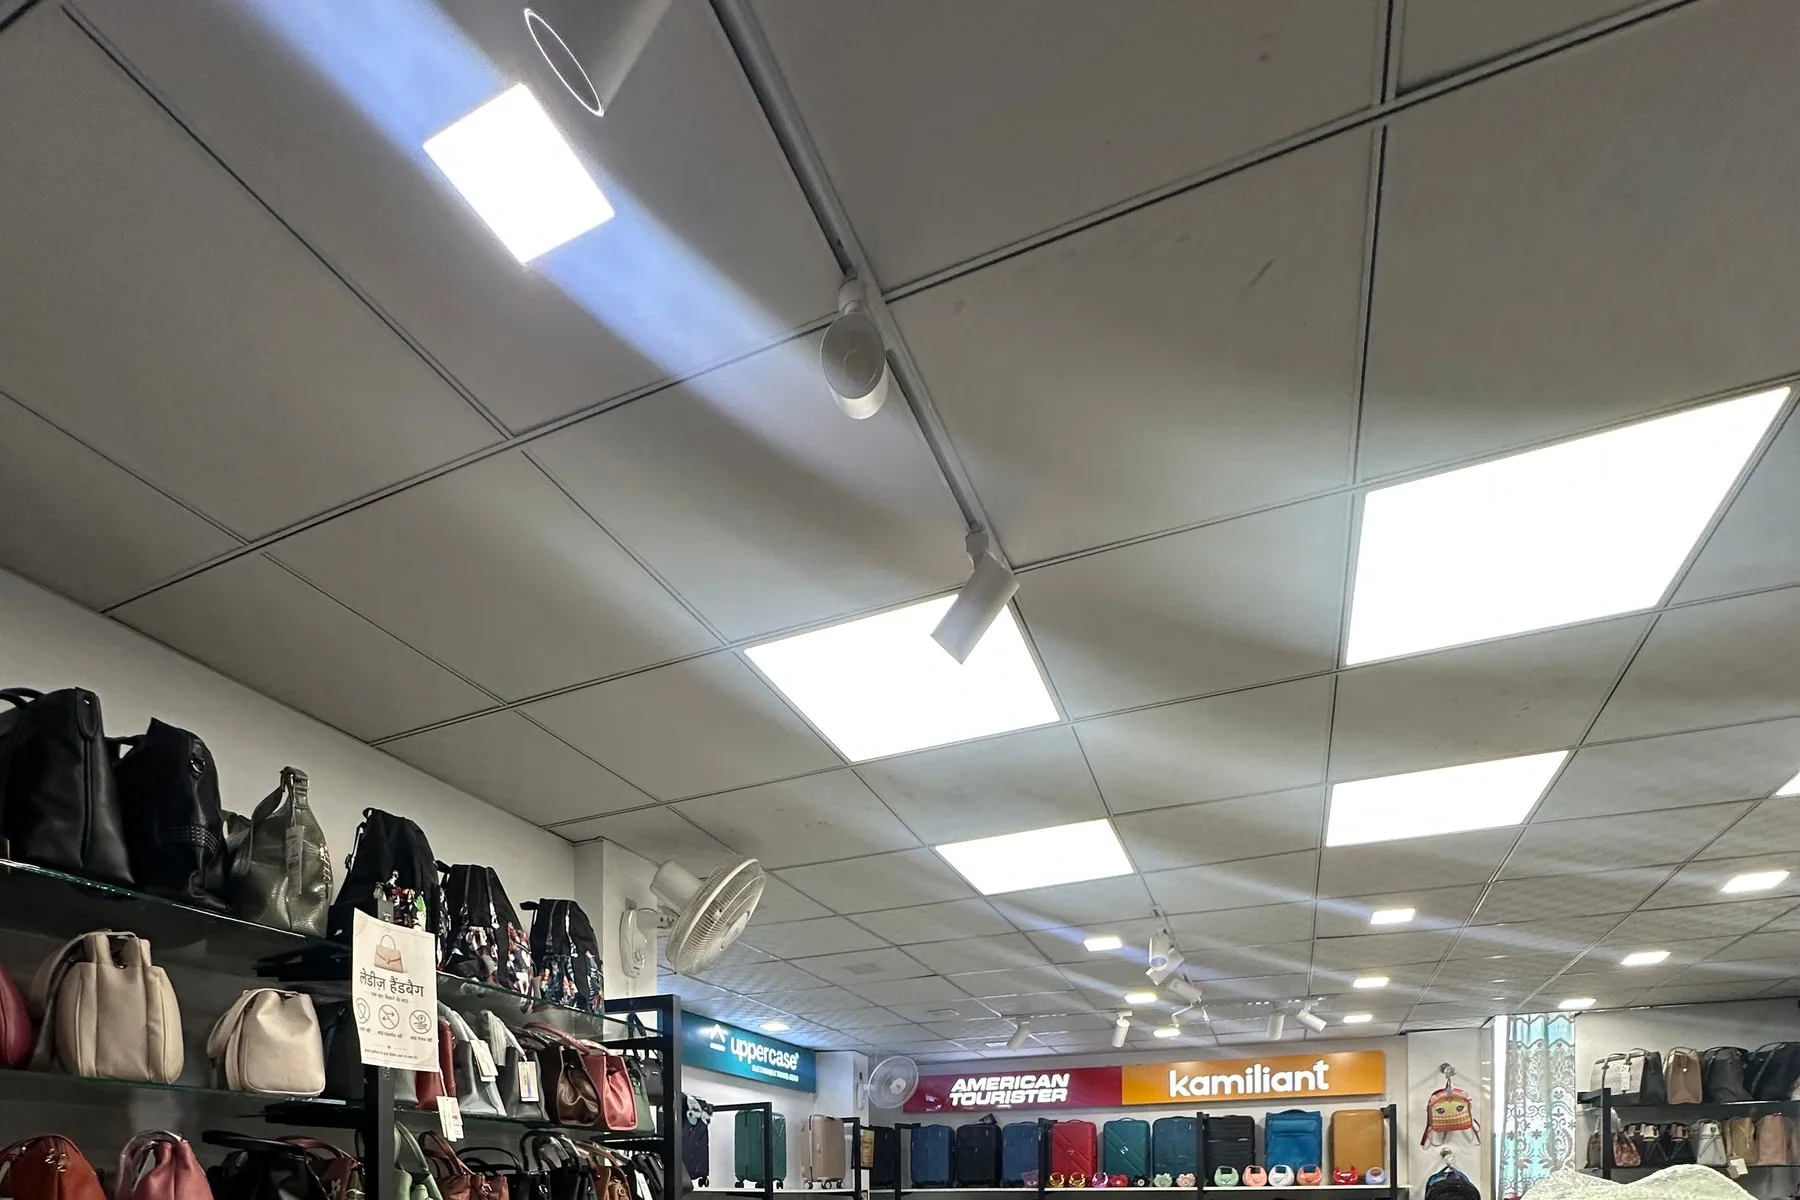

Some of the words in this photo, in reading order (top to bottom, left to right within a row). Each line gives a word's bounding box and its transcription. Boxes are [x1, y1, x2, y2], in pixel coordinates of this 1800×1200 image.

[359, 967, 386, 990] लेडीज़
[389, 975, 425, 998] हैंडबैग
[730, 1036, 799, 1070] uppercase
[951, 1073, 1070, 1092] AMERICAN
[1169, 1060, 1329, 1097] kamiliant
[950, 1088, 1068, 1107] TOURISTER
